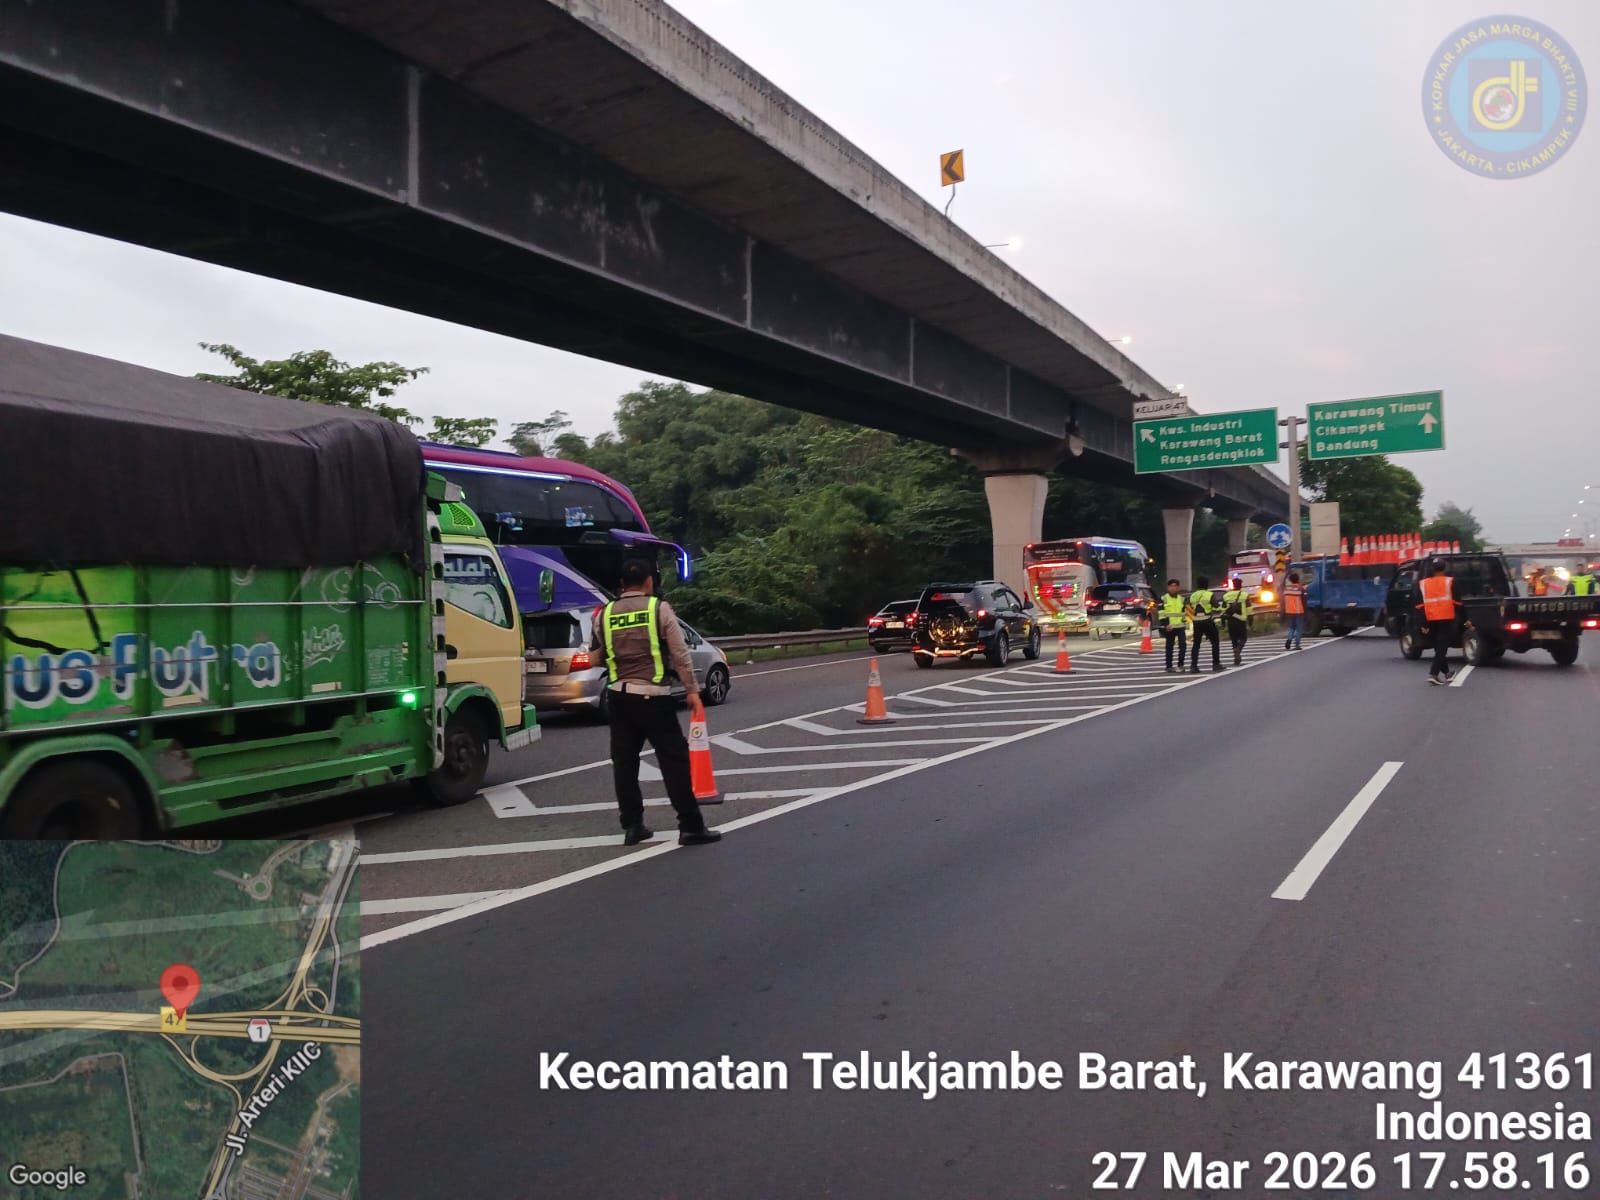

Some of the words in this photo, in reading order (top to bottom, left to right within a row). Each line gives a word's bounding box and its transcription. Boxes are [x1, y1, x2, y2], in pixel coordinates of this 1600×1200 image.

[1314, 406, 1384, 420] Karawang
[1389, 402, 1433, 413] Timur
[1159, 425, 1187, 436] Kws.
[1190, 419, 1243, 433] Industri
[1315, 421, 1385, 437] Cikampek
[1160, 436, 1222, 450] Karawang
[1225, 432, 1263, 444] Barat
[1316, 439, 1378, 452] Bandung
[1161, 448, 1265, 465] Rengasdengklok
[1517, 601, 1595, 613] MITSUBISHI
[609, 612, 650, 629] POLISI
